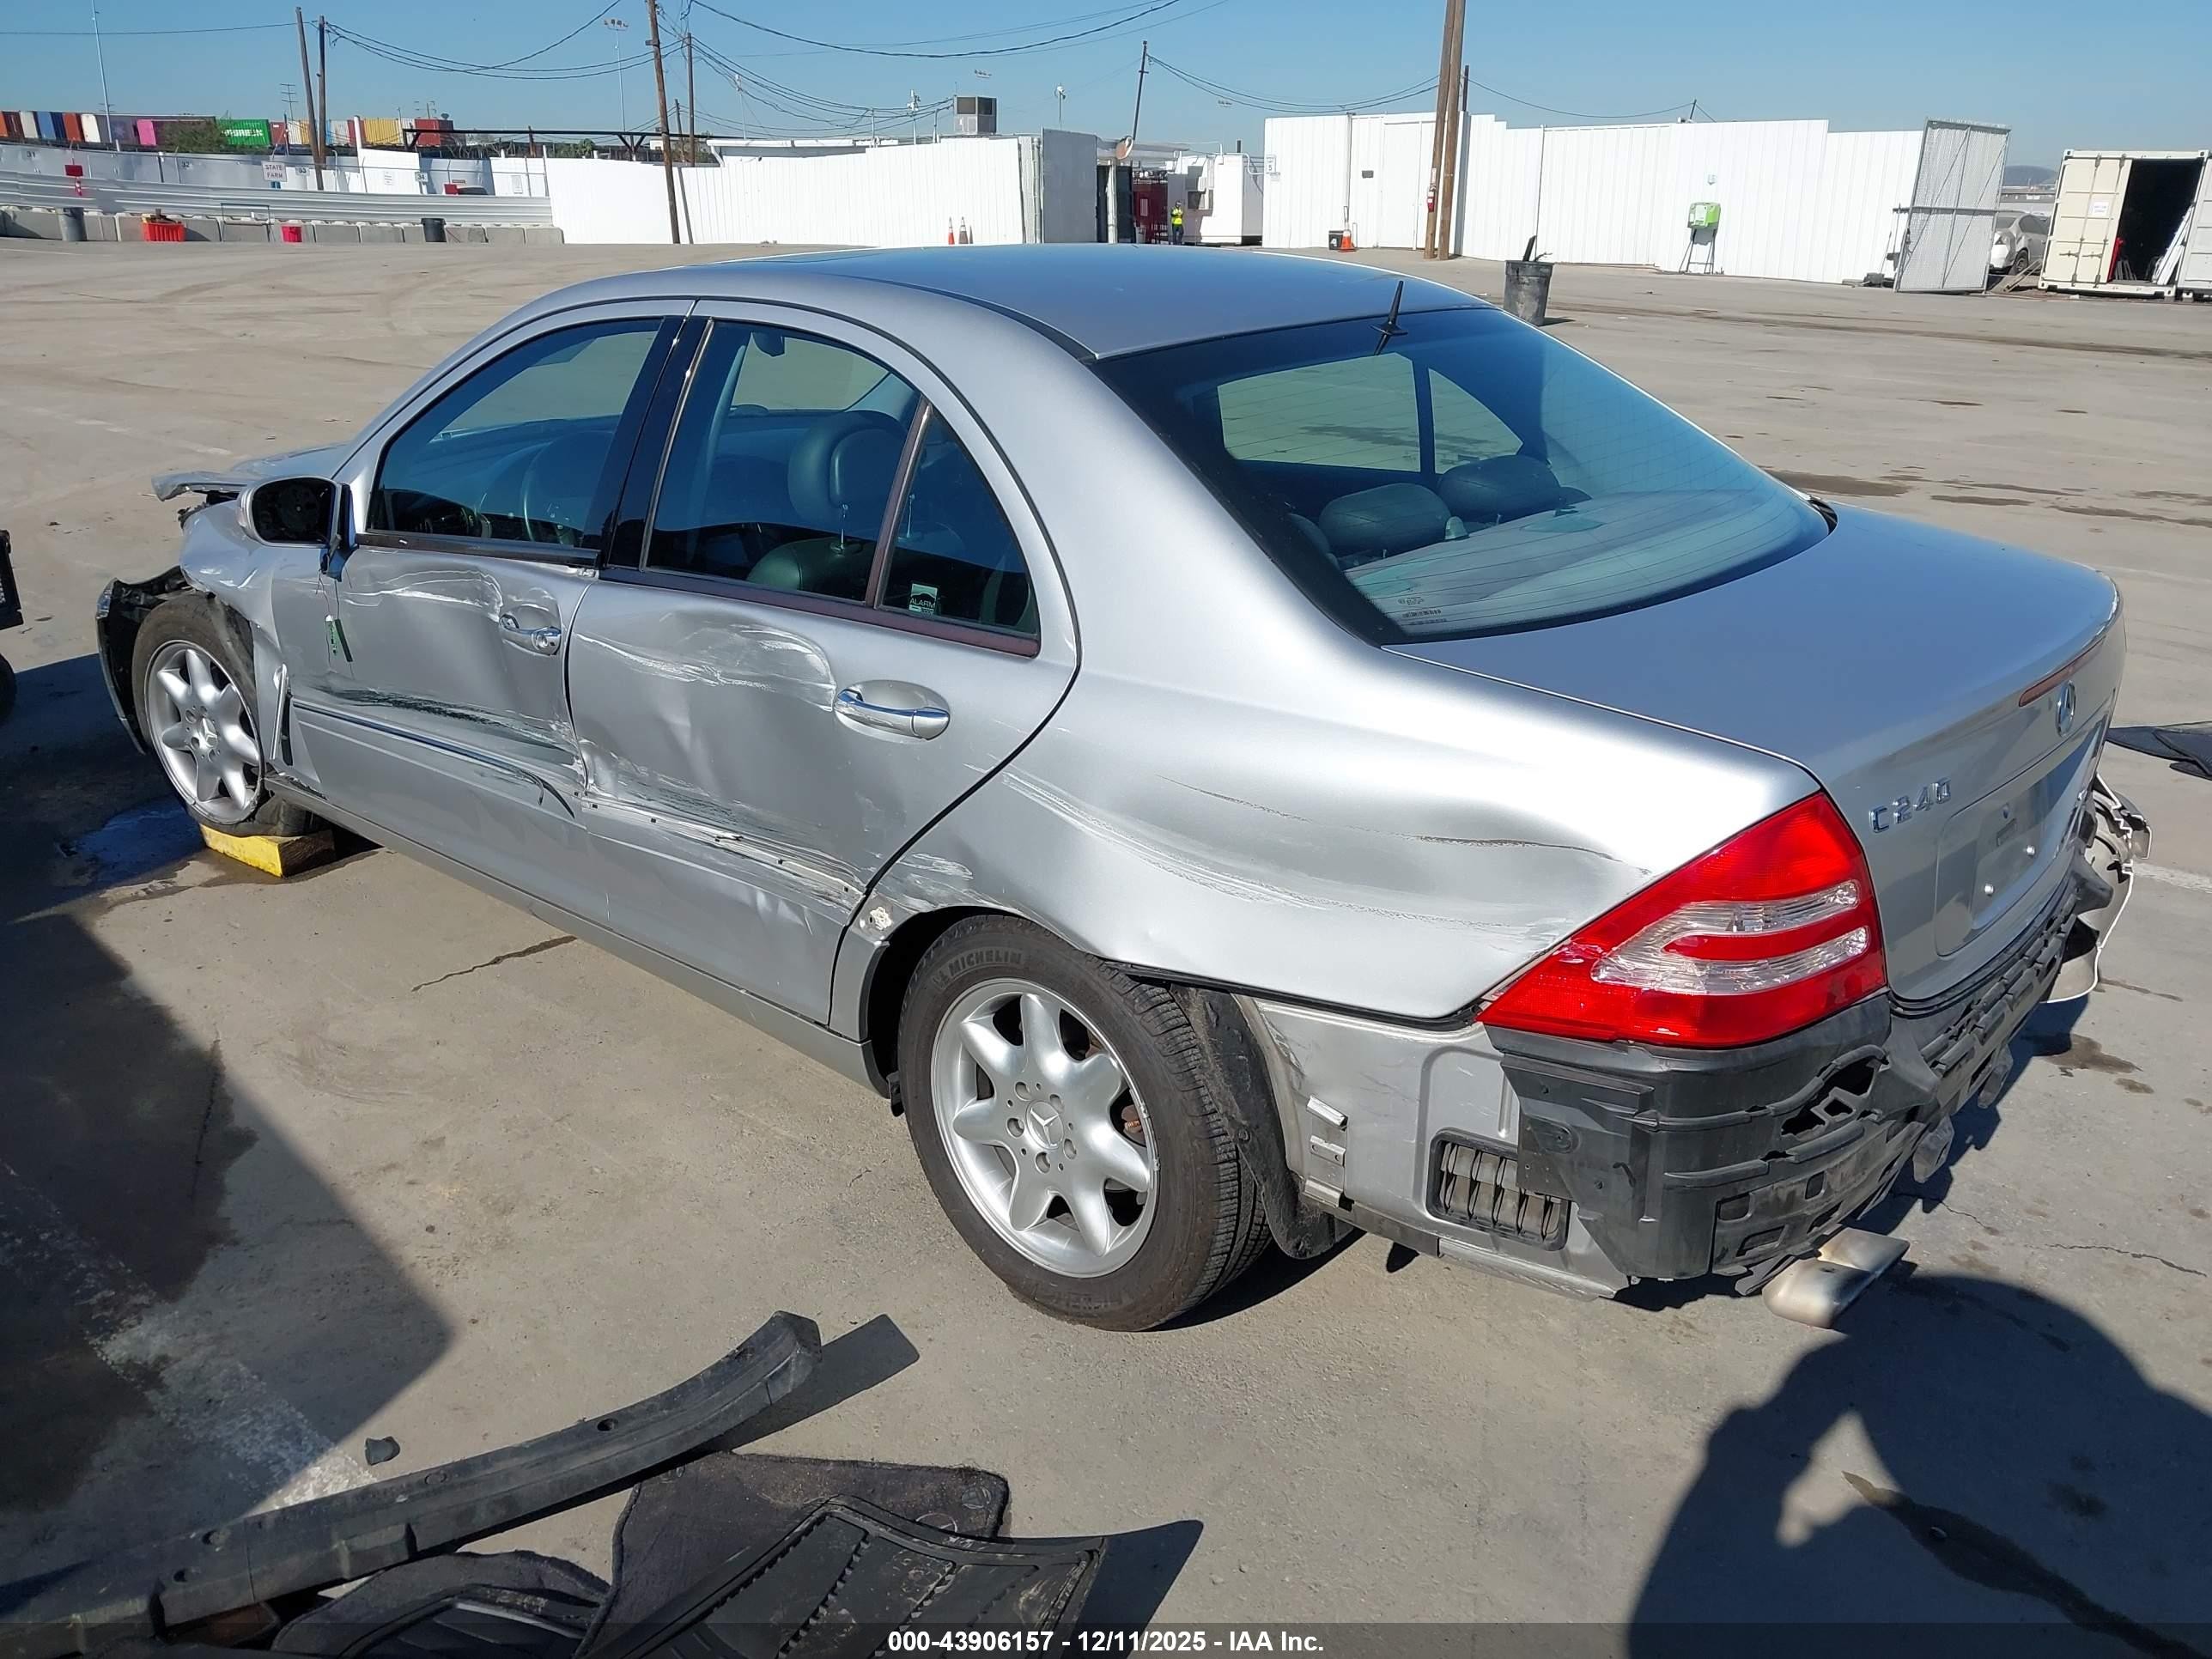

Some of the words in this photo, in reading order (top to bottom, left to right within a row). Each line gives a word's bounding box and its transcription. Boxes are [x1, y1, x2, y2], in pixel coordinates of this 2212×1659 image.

[909, 598, 935, 609] ALARM
[1869, 777, 1951, 834] C240
[948, 949, 1022, 977] MICHELIN
